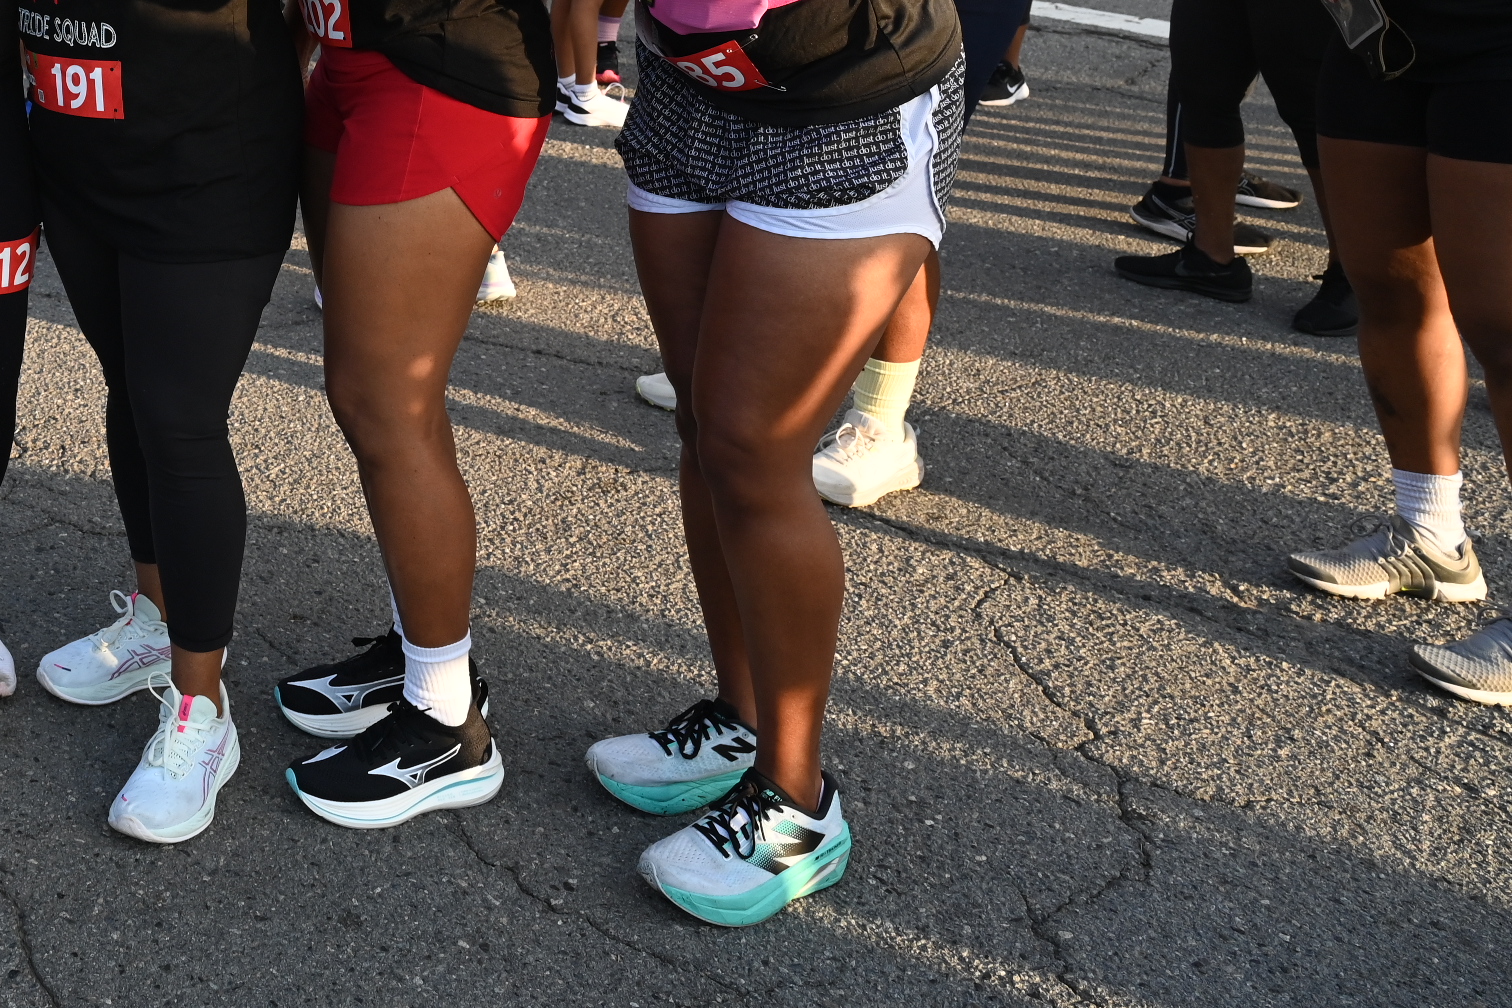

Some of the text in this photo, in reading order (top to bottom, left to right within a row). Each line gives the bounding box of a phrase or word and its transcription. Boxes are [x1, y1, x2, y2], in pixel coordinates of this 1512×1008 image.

[54, 17, 116, 48] SQUAD
[51, 63, 105, 112] 191
[676, 52, 745, 88] 85
